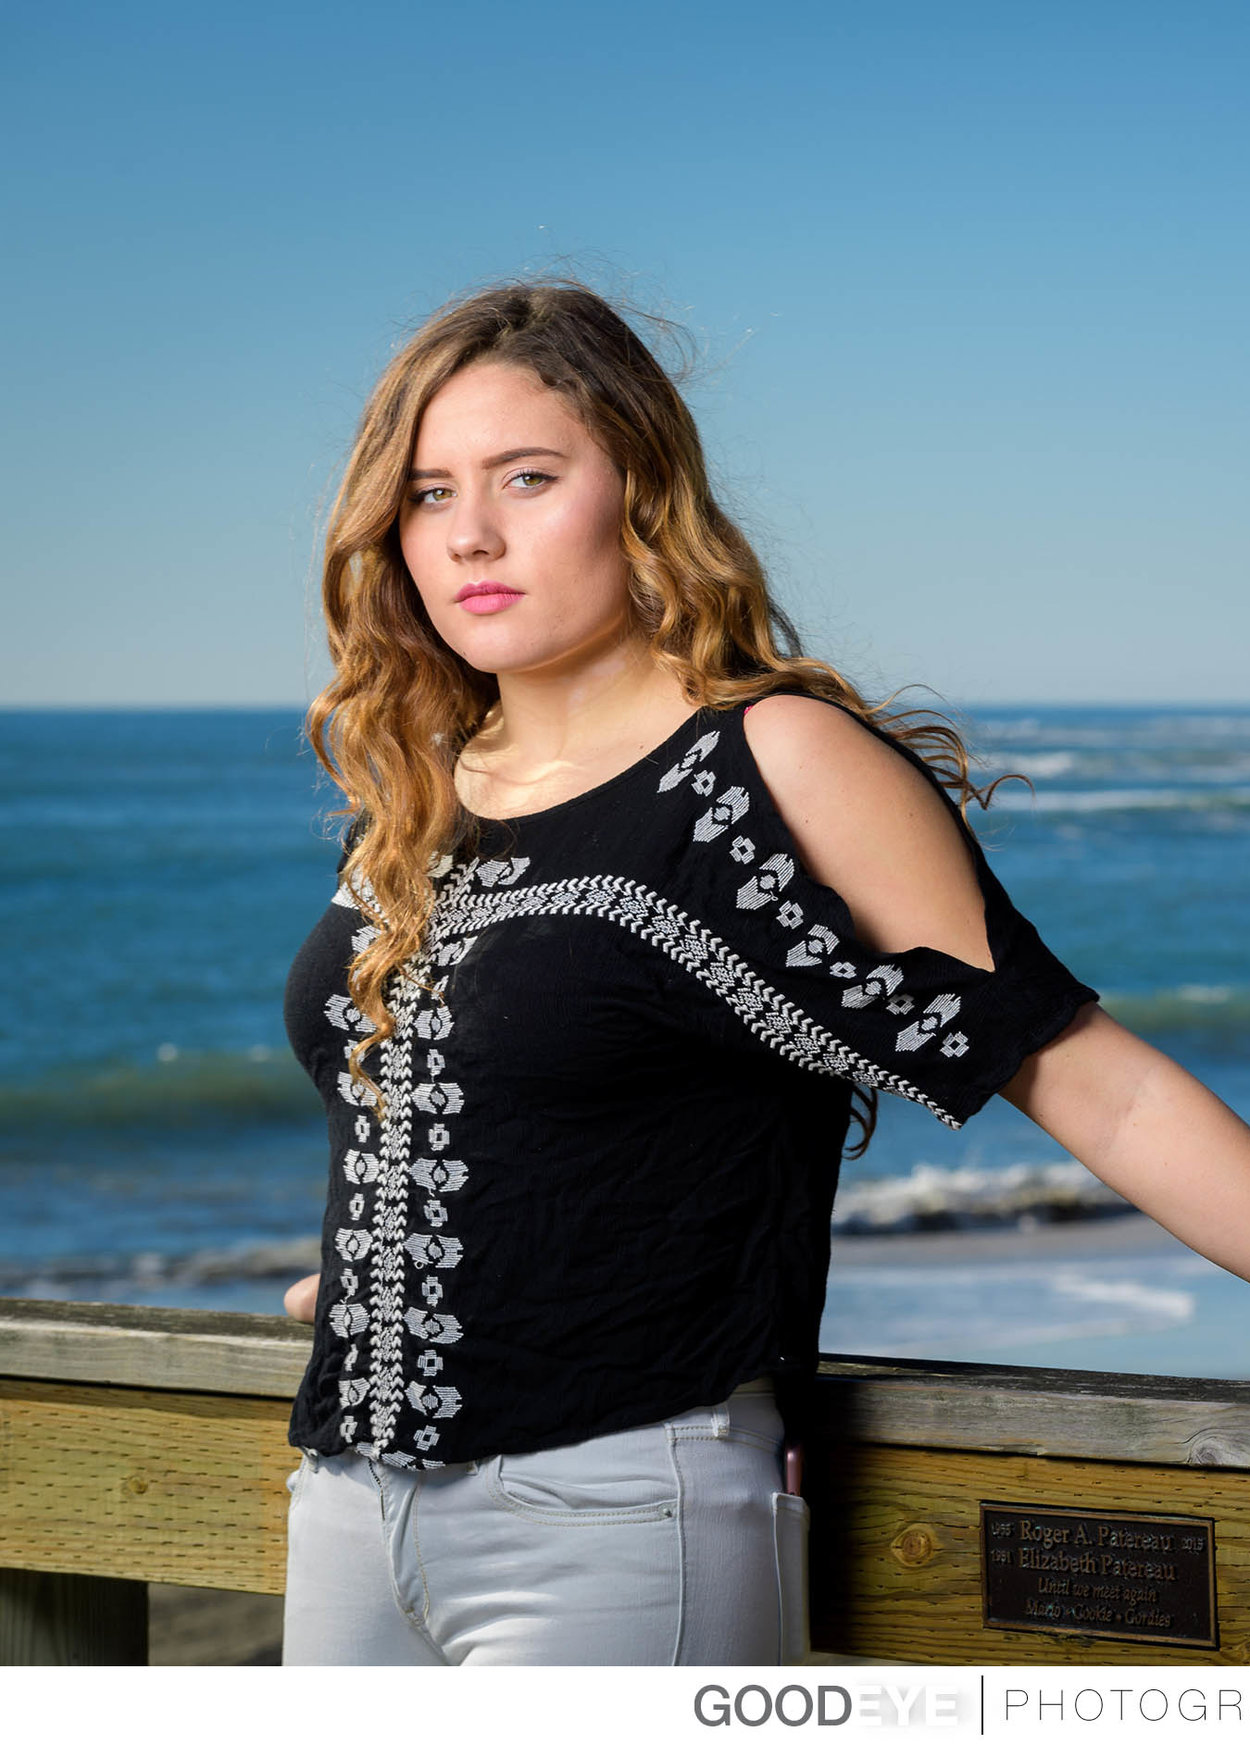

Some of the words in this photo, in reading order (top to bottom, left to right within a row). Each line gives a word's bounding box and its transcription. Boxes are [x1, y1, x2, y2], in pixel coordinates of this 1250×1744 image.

[1019, 1519, 1070, 1549] Roger
[1074, 1522, 1092, 1545] A.
[1098, 1526, 1173, 1550] Patereau
[1018, 1547, 1096, 1574] Elizabeth
[1101, 1554, 1176, 1580] Patereau
[1038, 1577, 1070, 1595] Until
[1073, 1584, 1089, 1597] we
[1093, 1584, 1120, 1600] meet
[1123, 1586, 1156, 1606] again
